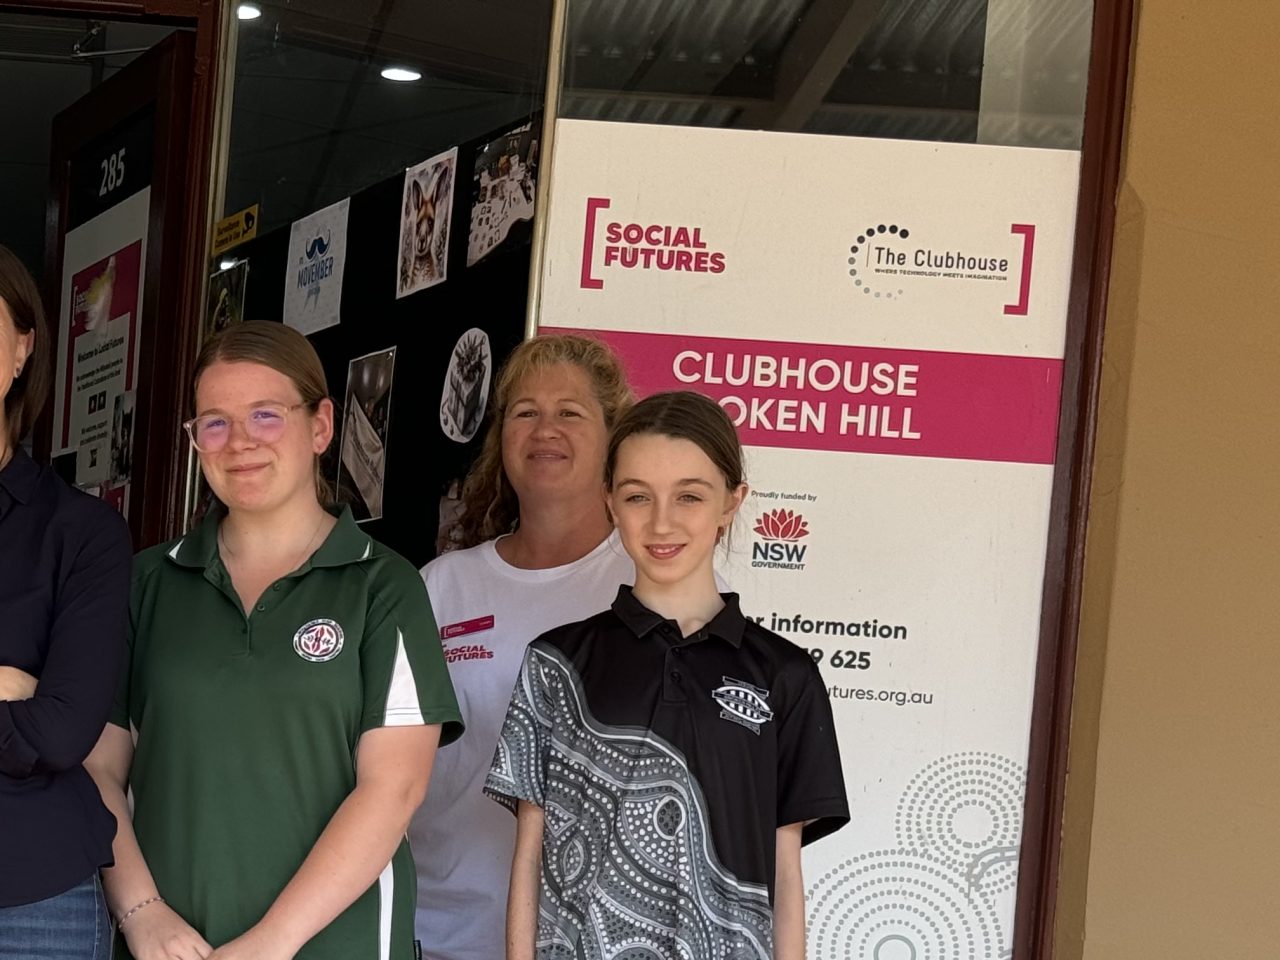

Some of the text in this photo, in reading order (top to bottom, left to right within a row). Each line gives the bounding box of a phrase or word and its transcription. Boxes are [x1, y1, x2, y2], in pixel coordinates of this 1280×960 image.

[99, 147, 126, 197] 285
[606, 222, 707, 249] SOCIAL
[604, 246, 726, 273] FUTURES
[874, 247, 1008, 272] The Clubhouse
[672, 350, 920, 397] CLUBHOUSE
[718, 396, 921, 439] OKEN HILL
[751, 490, 817, 502] Proudly funded by
[752, 541, 807, 563] NSW
[751, 561, 805, 570] GOVERNMENT
[771, 612, 907, 640] information
[444, 645, 486, 656] SOCIAL
[830, 651, 871, 670] 625
